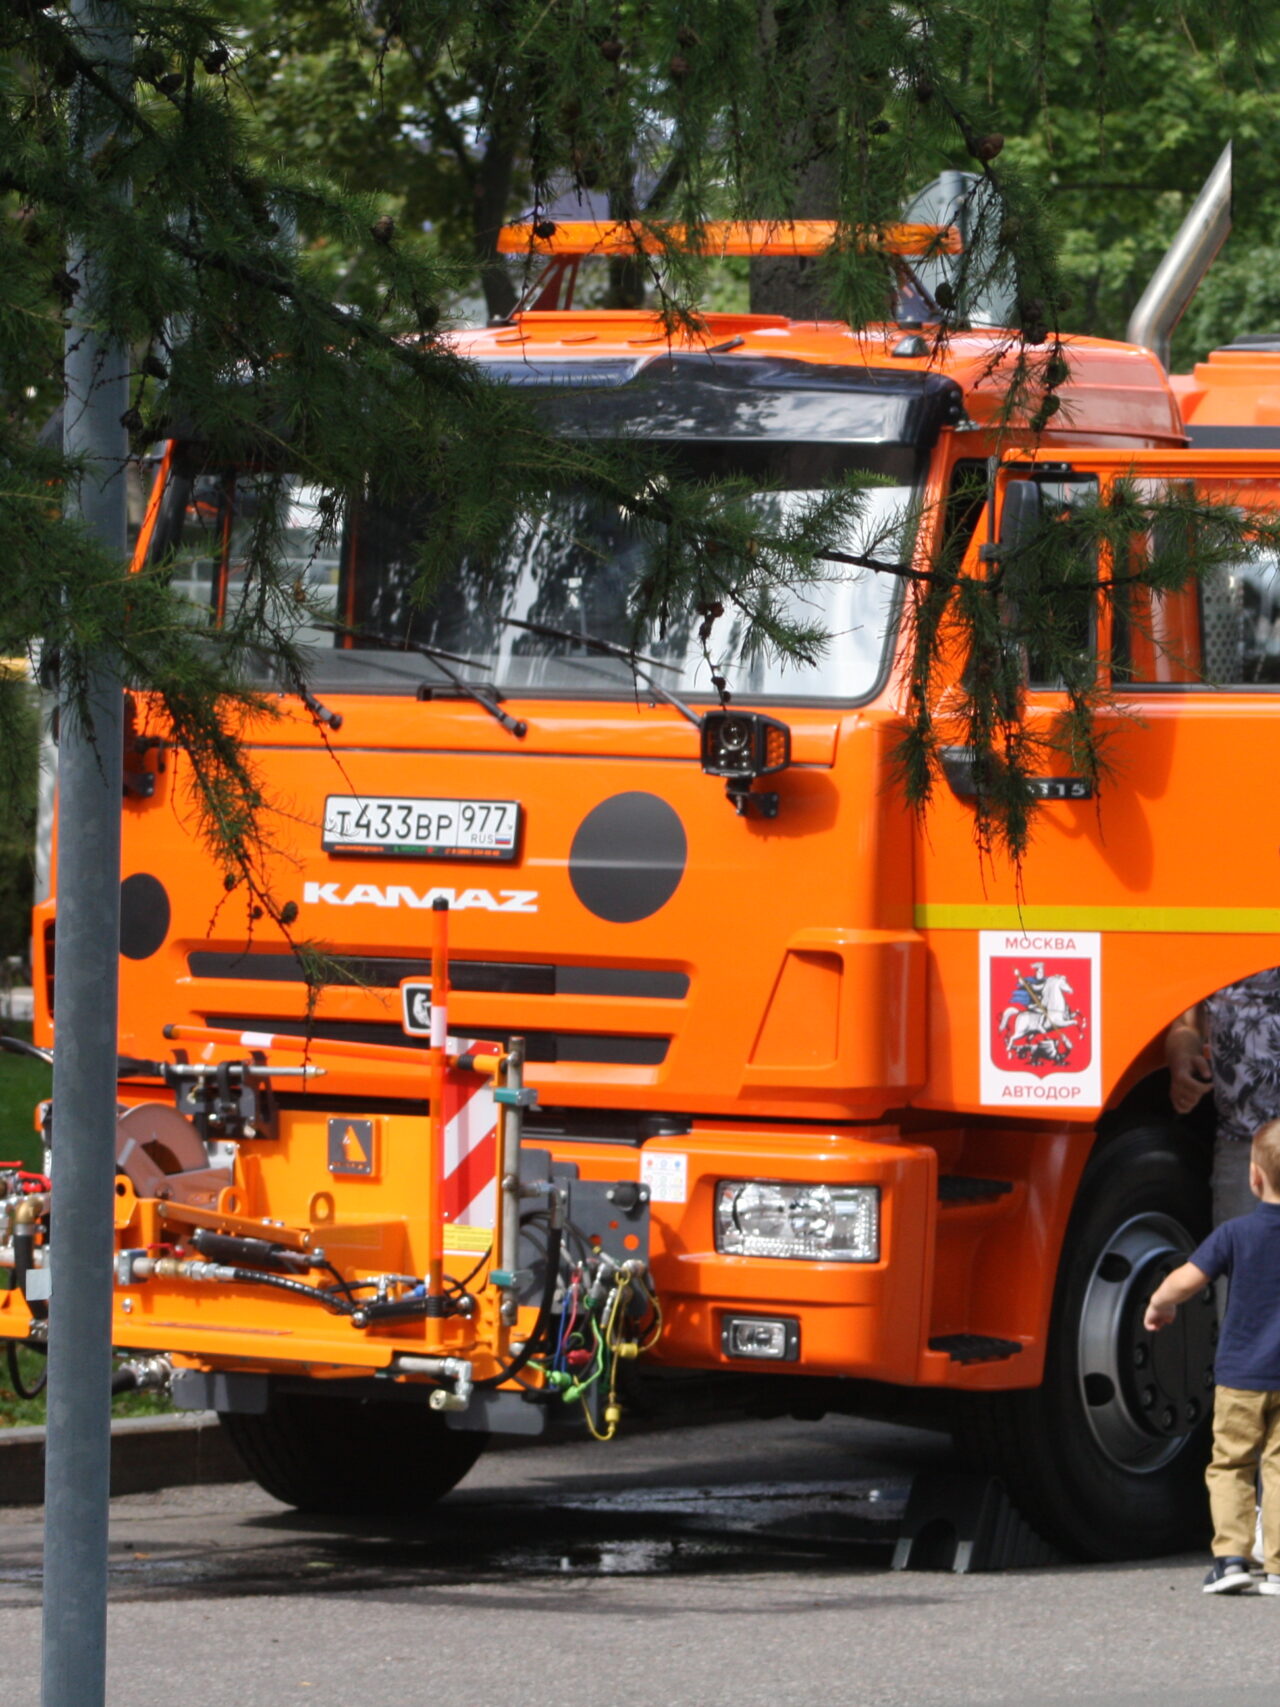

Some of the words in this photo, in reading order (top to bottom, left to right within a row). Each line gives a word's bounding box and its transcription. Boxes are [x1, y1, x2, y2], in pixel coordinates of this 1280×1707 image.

[461, 804, 508, 833] 977
[470, 833, 494, 845] RUS
[303, 881, 539, 913] KAMAZ
[1004, 936, 1077, 951] МОСКВА
[1001, 1084, 1082, 1100] АВТОДОР
